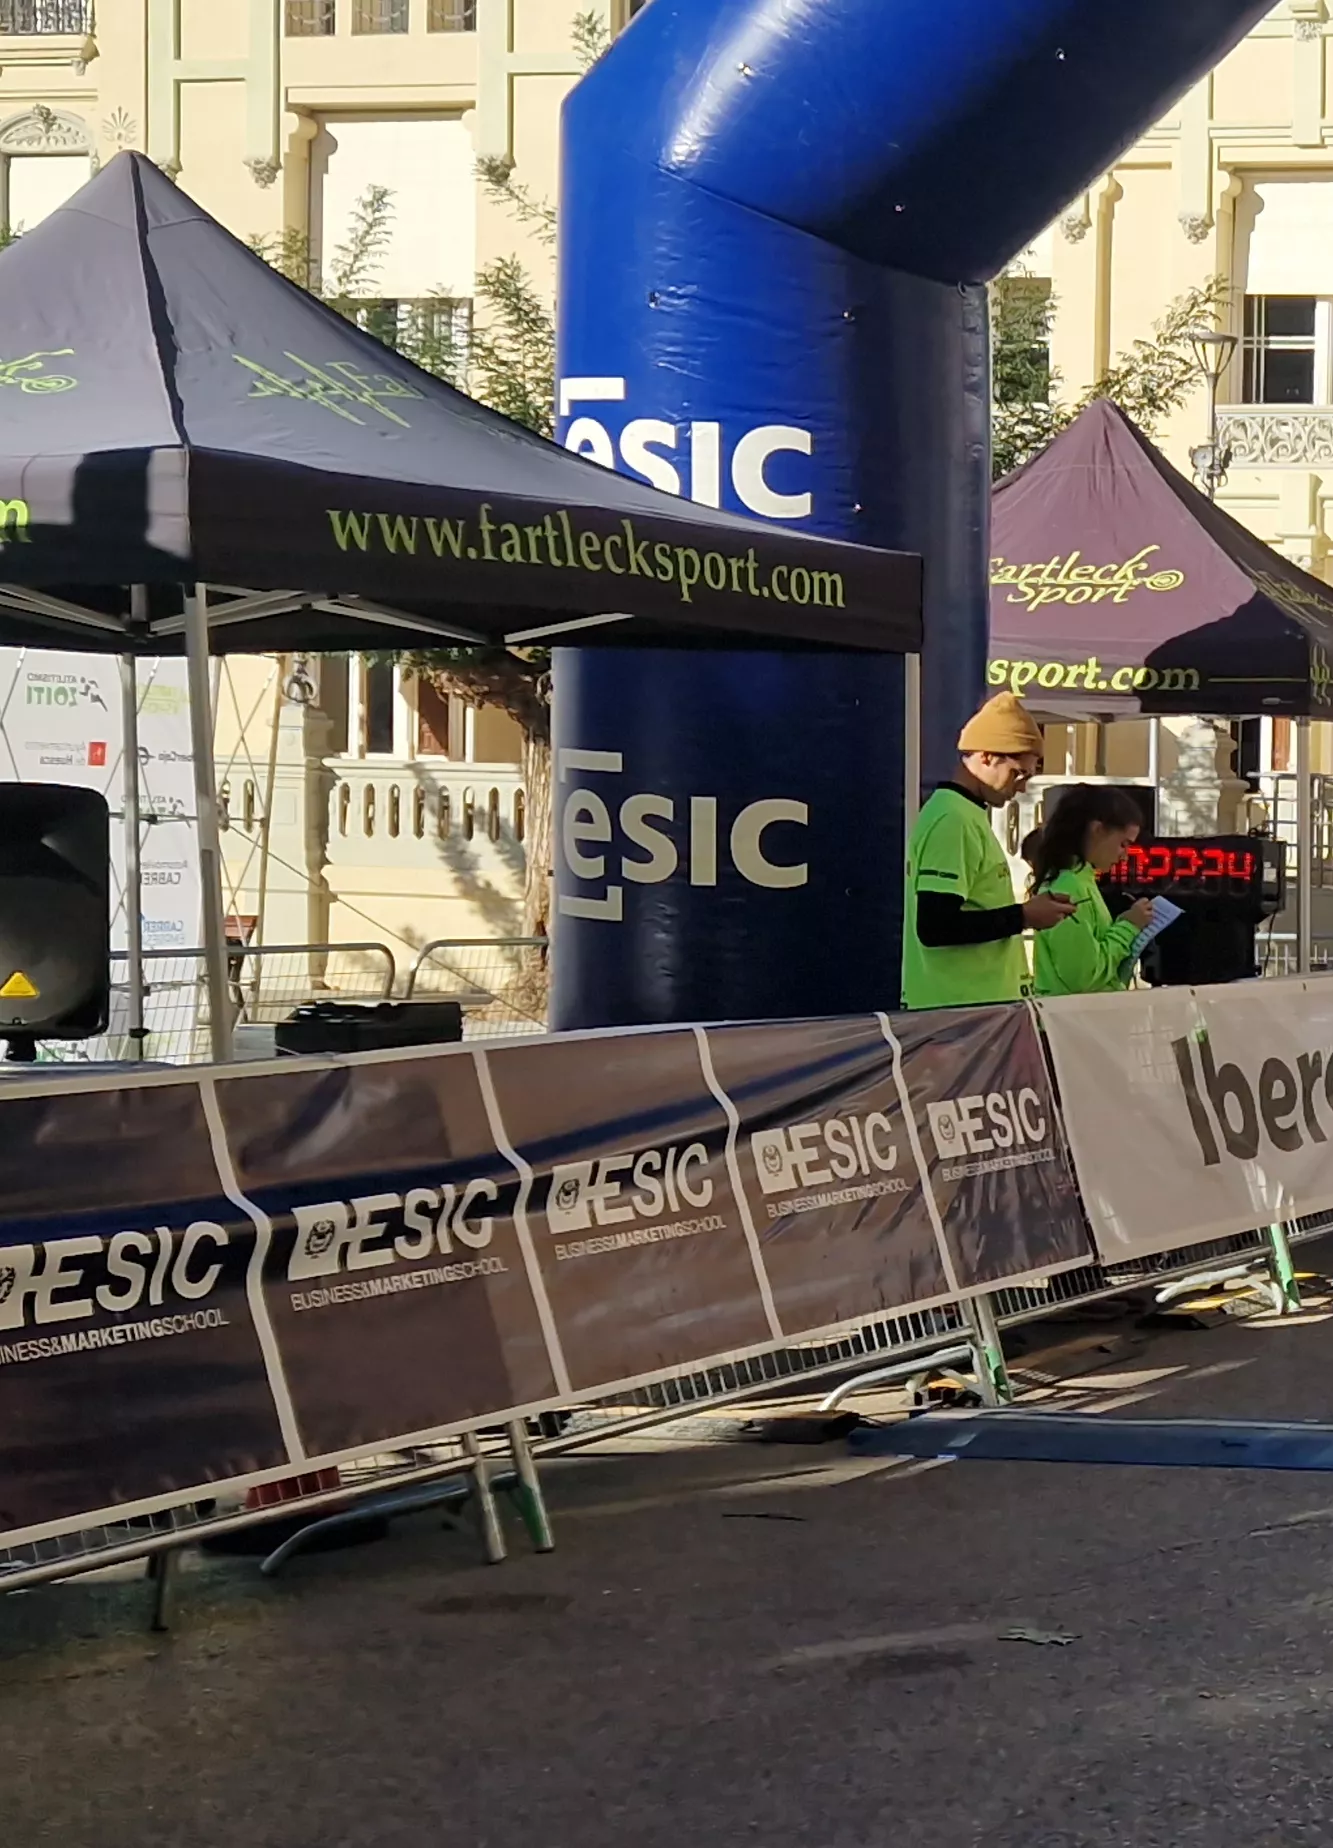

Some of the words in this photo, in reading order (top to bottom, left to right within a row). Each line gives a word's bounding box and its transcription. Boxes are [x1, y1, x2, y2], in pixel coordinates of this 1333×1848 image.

[326, 503, 846, 608] www.fartlecksport.com
[789, 1112, 897, 1187] ESIC
[957, 1087, 1046, 1154] ESIC
[347, 1178, 498, 1271] ESIC
[594, 1143, 713, 1225] ESIC
[35, 1221, 229, 1325] ESIC
